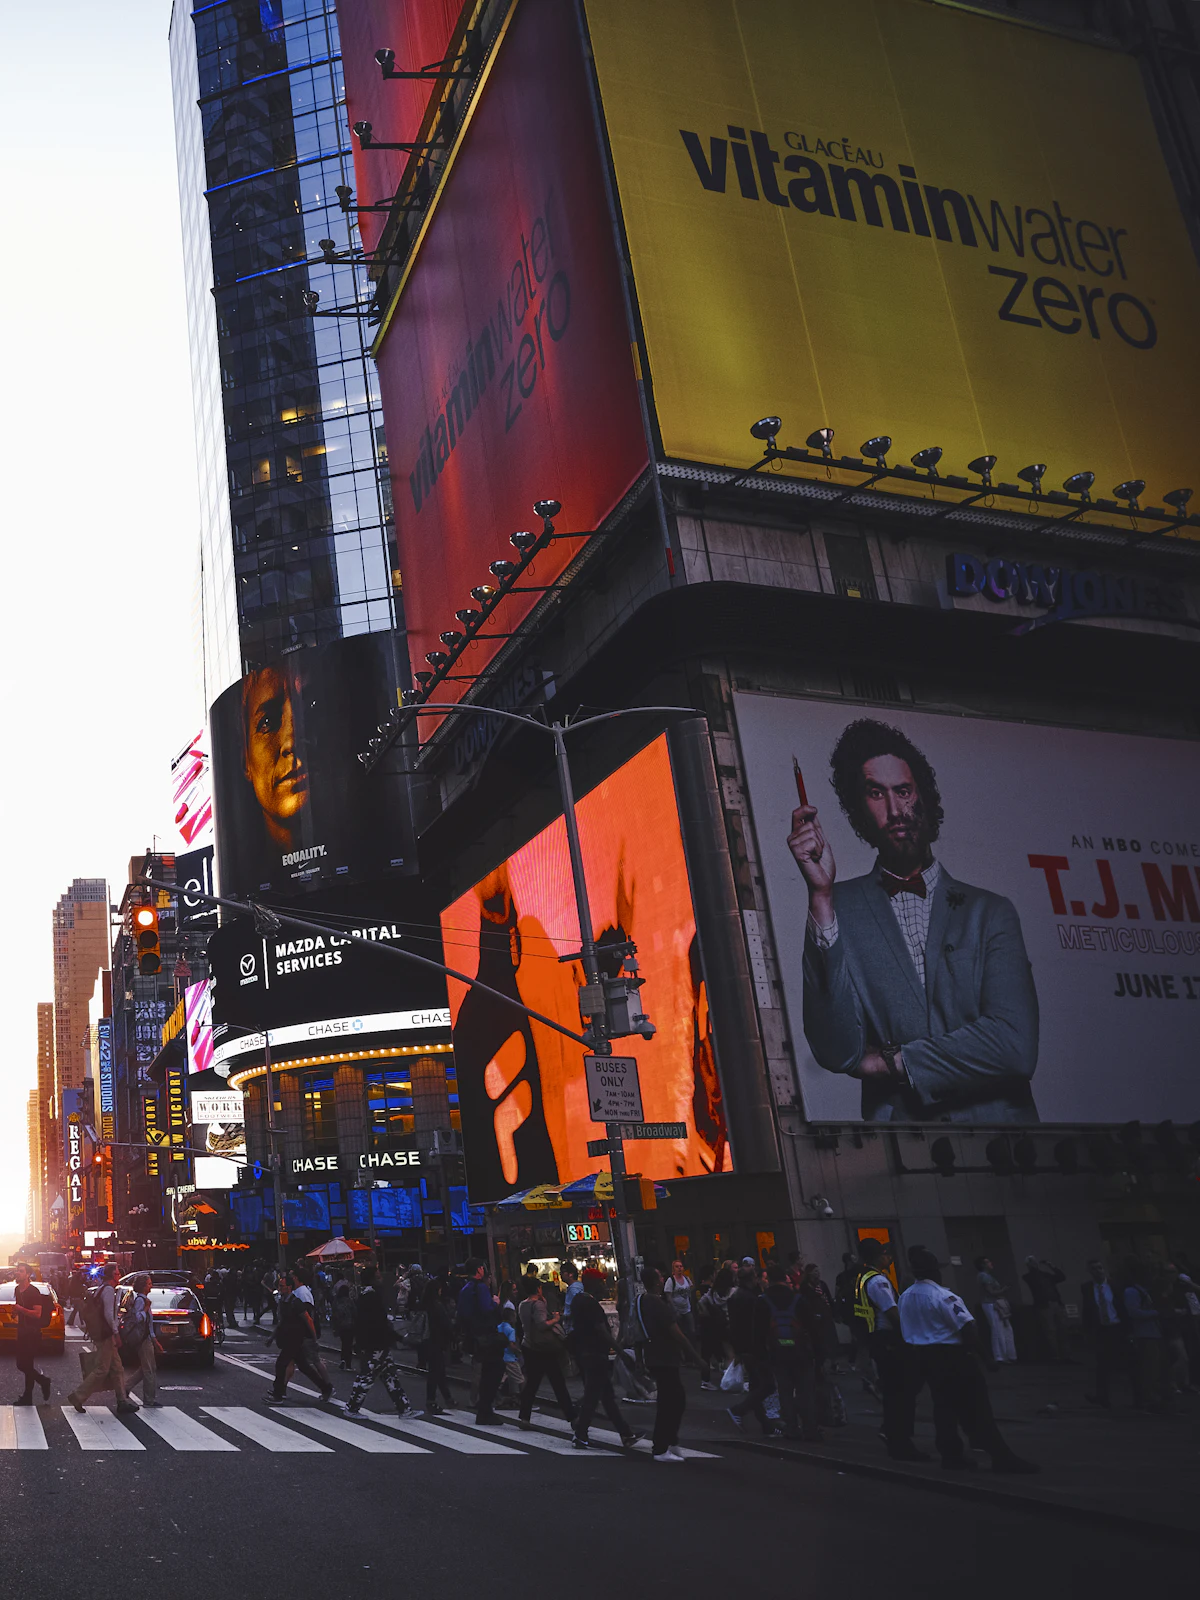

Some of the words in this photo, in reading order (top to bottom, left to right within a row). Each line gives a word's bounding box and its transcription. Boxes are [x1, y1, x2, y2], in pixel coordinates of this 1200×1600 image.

[679, 124, 1128, 281] vitaminwater
[987, 264, 1157, 349] zero
[501, 270, 571, 434] zero
[1071, 835, 1094, 850] AN
[1102, 838, 1141, 853] HBO
[275, 936, 325, 958] MAZDA
[276, 951, 343, 976] SERVICES
[1114, 973, 1178, 999] JUNE
[308, 1021, 349, 1036] CHASE
[240, 1035, 265, 1050] CHASE
[595, 1062, 627, 1073] BUSES
[600, 1076, 624, 1087] ONLY
[169, 1070, 183, 1126] VICTORY
[199, 1103, 241, 1111] WORK
[636, 1125, 683, 1137] Broadway
[172, 1133, 184, 1160] NW
[69, 1124, 81, 1202] REGAL
[293, 1156, 338, 1173] CHASE
[359, 1151, 420, 1168] CHASE
[569, 1225, 599, 1240] SODA
